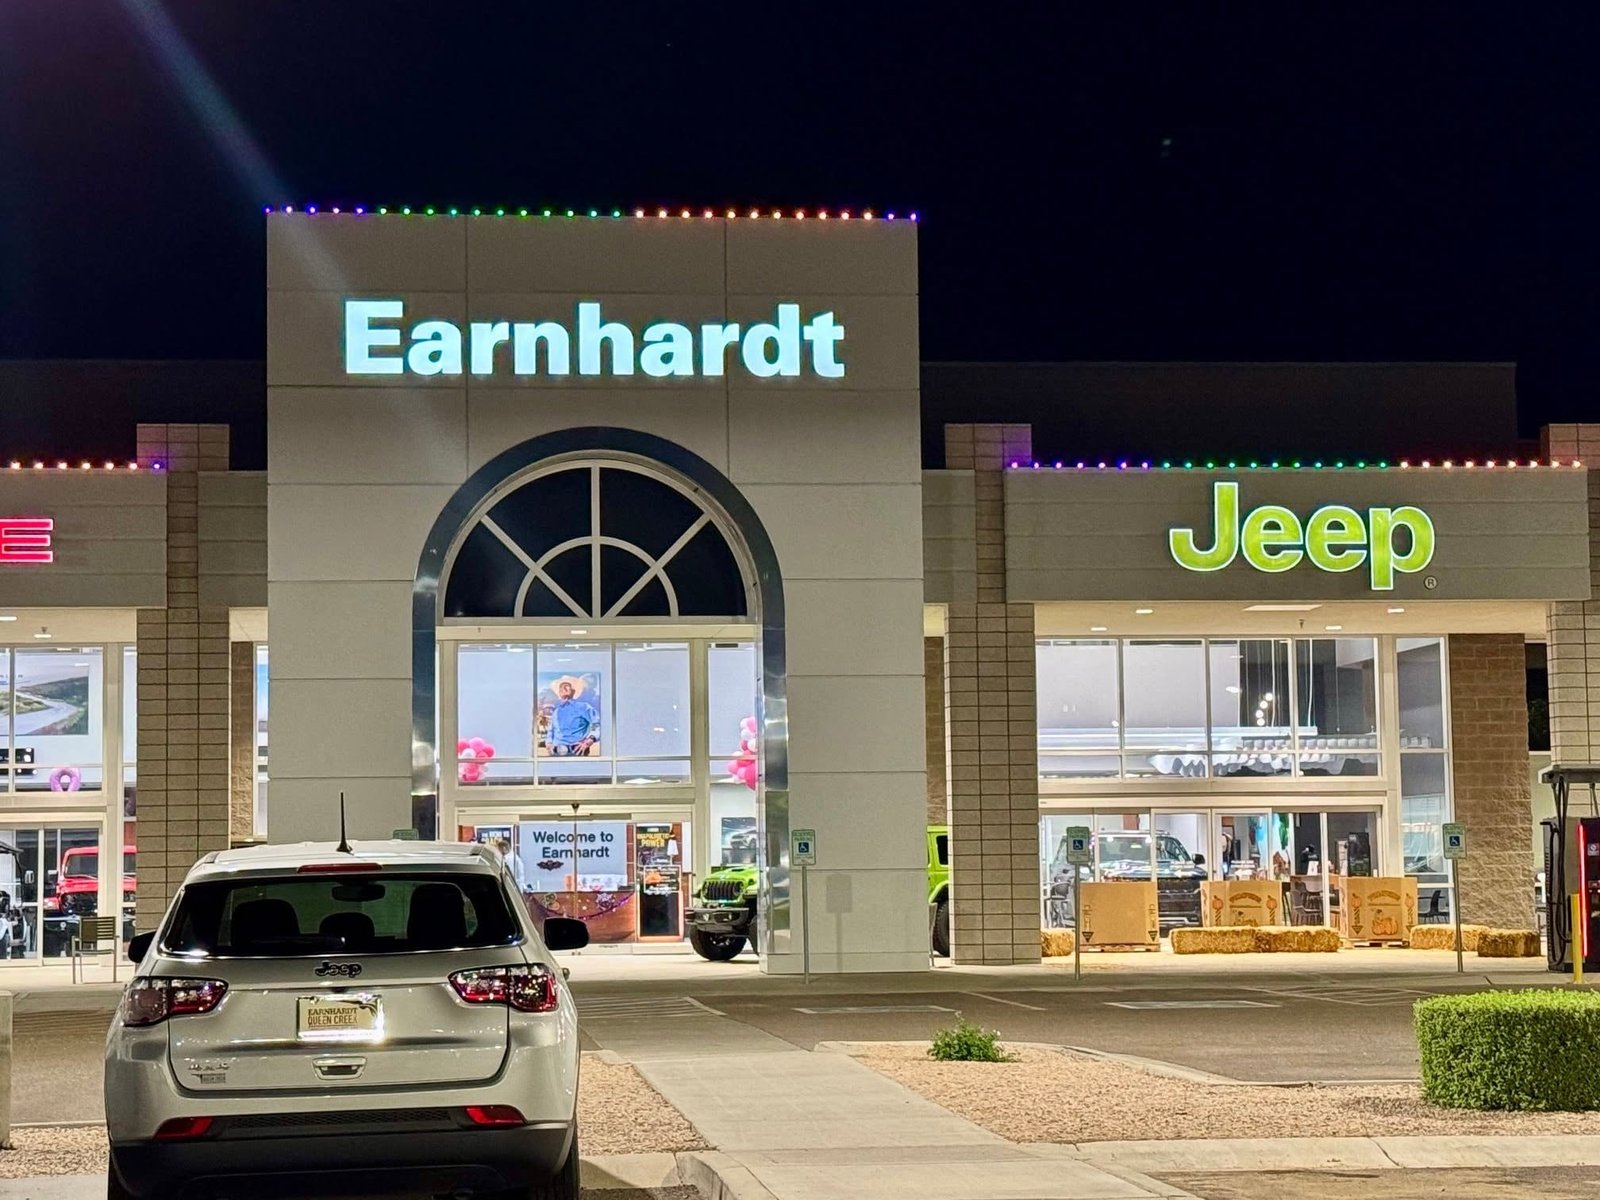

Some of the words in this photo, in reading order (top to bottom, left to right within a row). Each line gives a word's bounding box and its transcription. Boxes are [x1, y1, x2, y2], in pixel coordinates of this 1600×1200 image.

[345, 299, 845, 378] Earnhardt
[1169, 481, 1436, 591] Jeep
[533, 831, 596, 843] Welcome
[600, 831, 614, 842] to
[315, 961, 362, 978] Jeep
[308, 1008, 358, 1016] EARNHARDT
[308, 1015, 332, 1025] QUEEN
